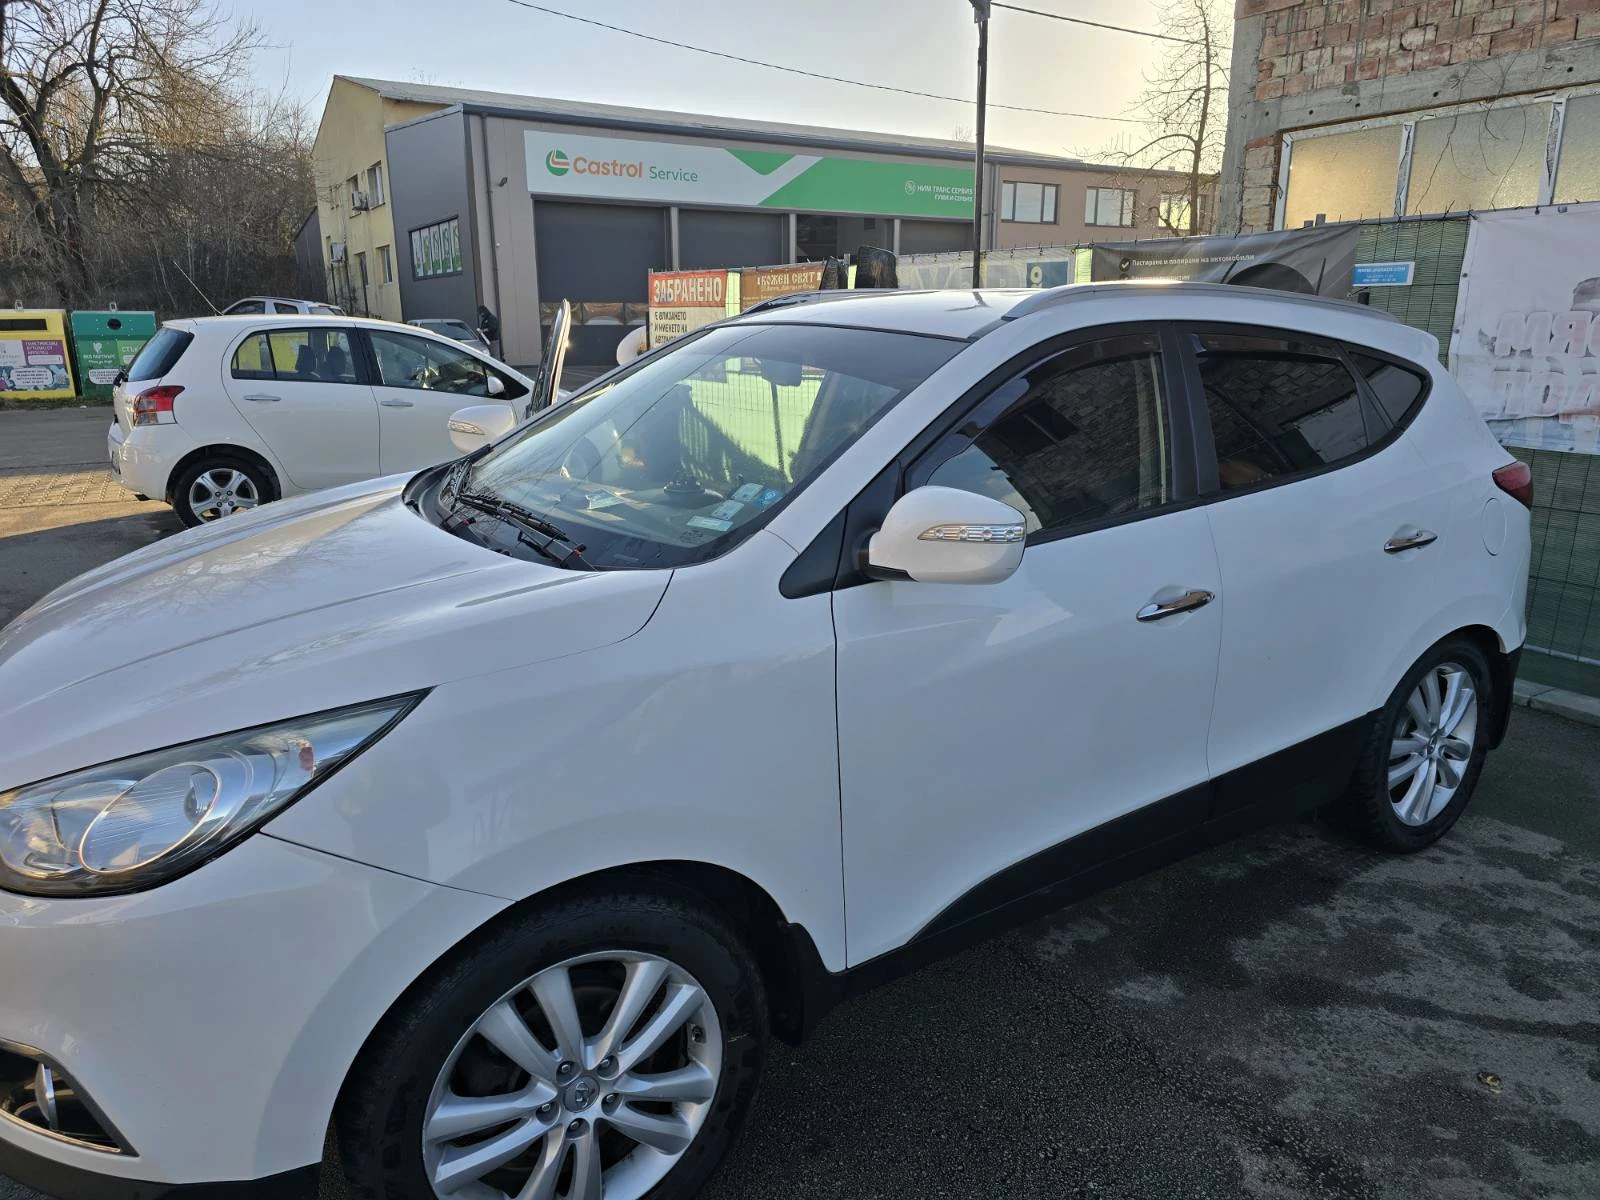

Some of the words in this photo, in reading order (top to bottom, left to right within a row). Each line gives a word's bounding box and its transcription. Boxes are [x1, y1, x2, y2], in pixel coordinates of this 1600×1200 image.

[573, 156, 644, 178] Castrol
[649, 166, 698, 182] Service
[1210, 253, 1255, 263] автомобили
[761, 273, 790, 286] КОЖЕН
[791, 271, 816, 284] СВЯТ
[654, 277, 722, 303] ЗАБРАНЕНО
[659, 311, 687, 321] ВЛИЗАНЕТО
